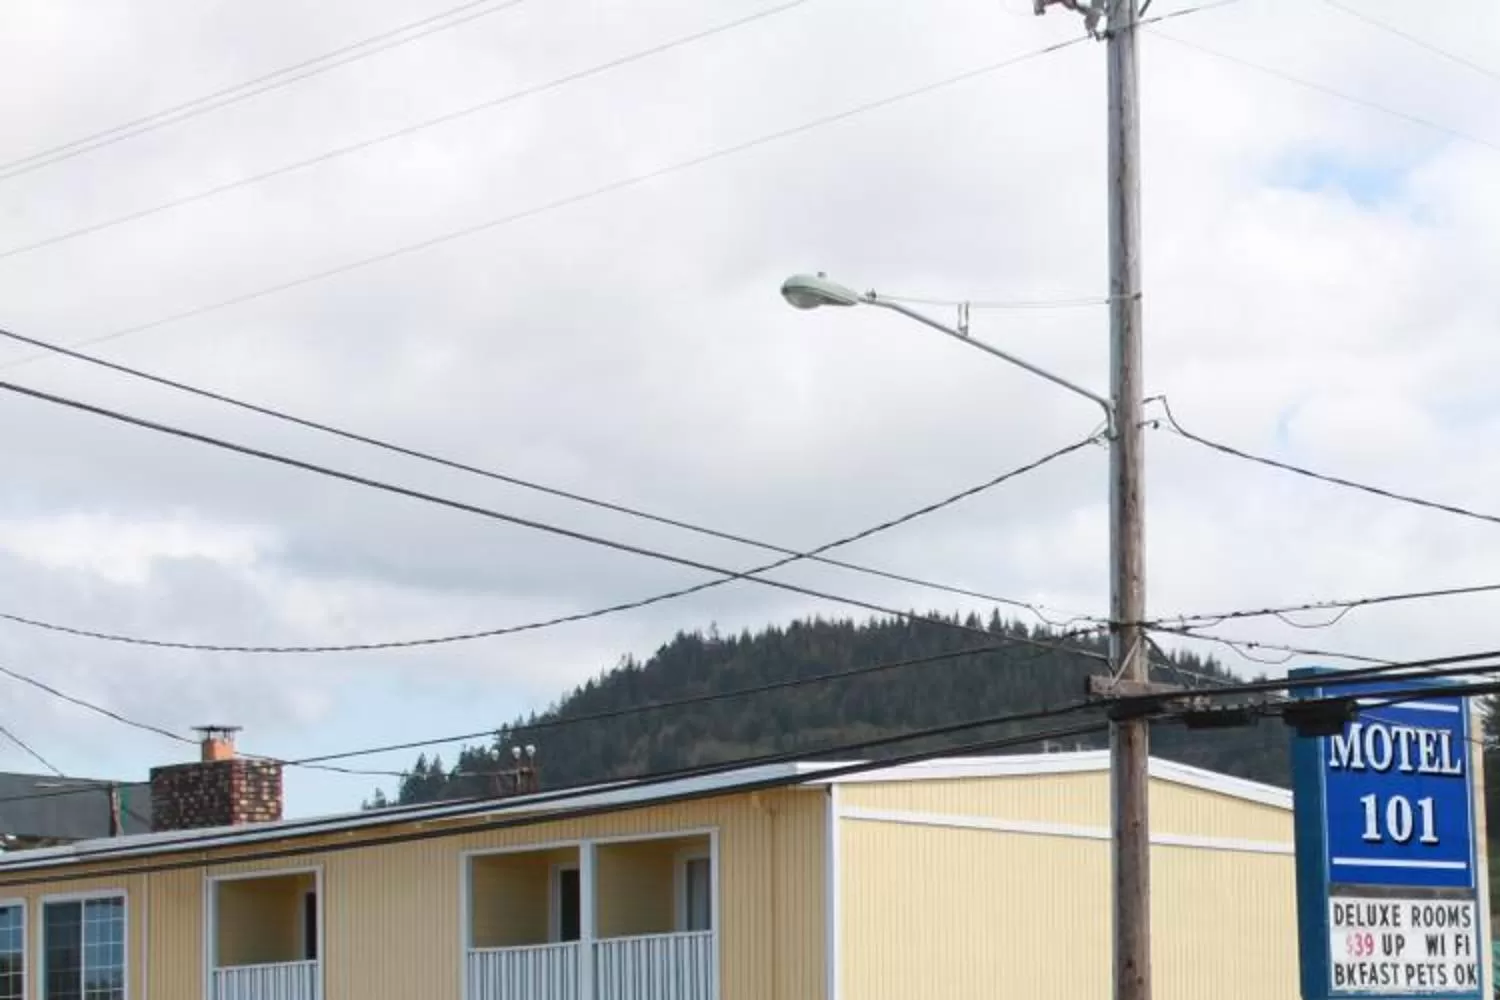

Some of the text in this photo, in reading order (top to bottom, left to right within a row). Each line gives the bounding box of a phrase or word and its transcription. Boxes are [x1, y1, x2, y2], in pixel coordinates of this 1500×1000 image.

[1329, 722, 1462, 775] MOTEL
[1360, 793, 1439, 843] 101
[1333, 903, 1471, 929] DELUXE ROOMS
[1346, 933, 1470, 957] $39 UP WI FI
[1334, 962, 1478, 986] BKFAST PETS OK
